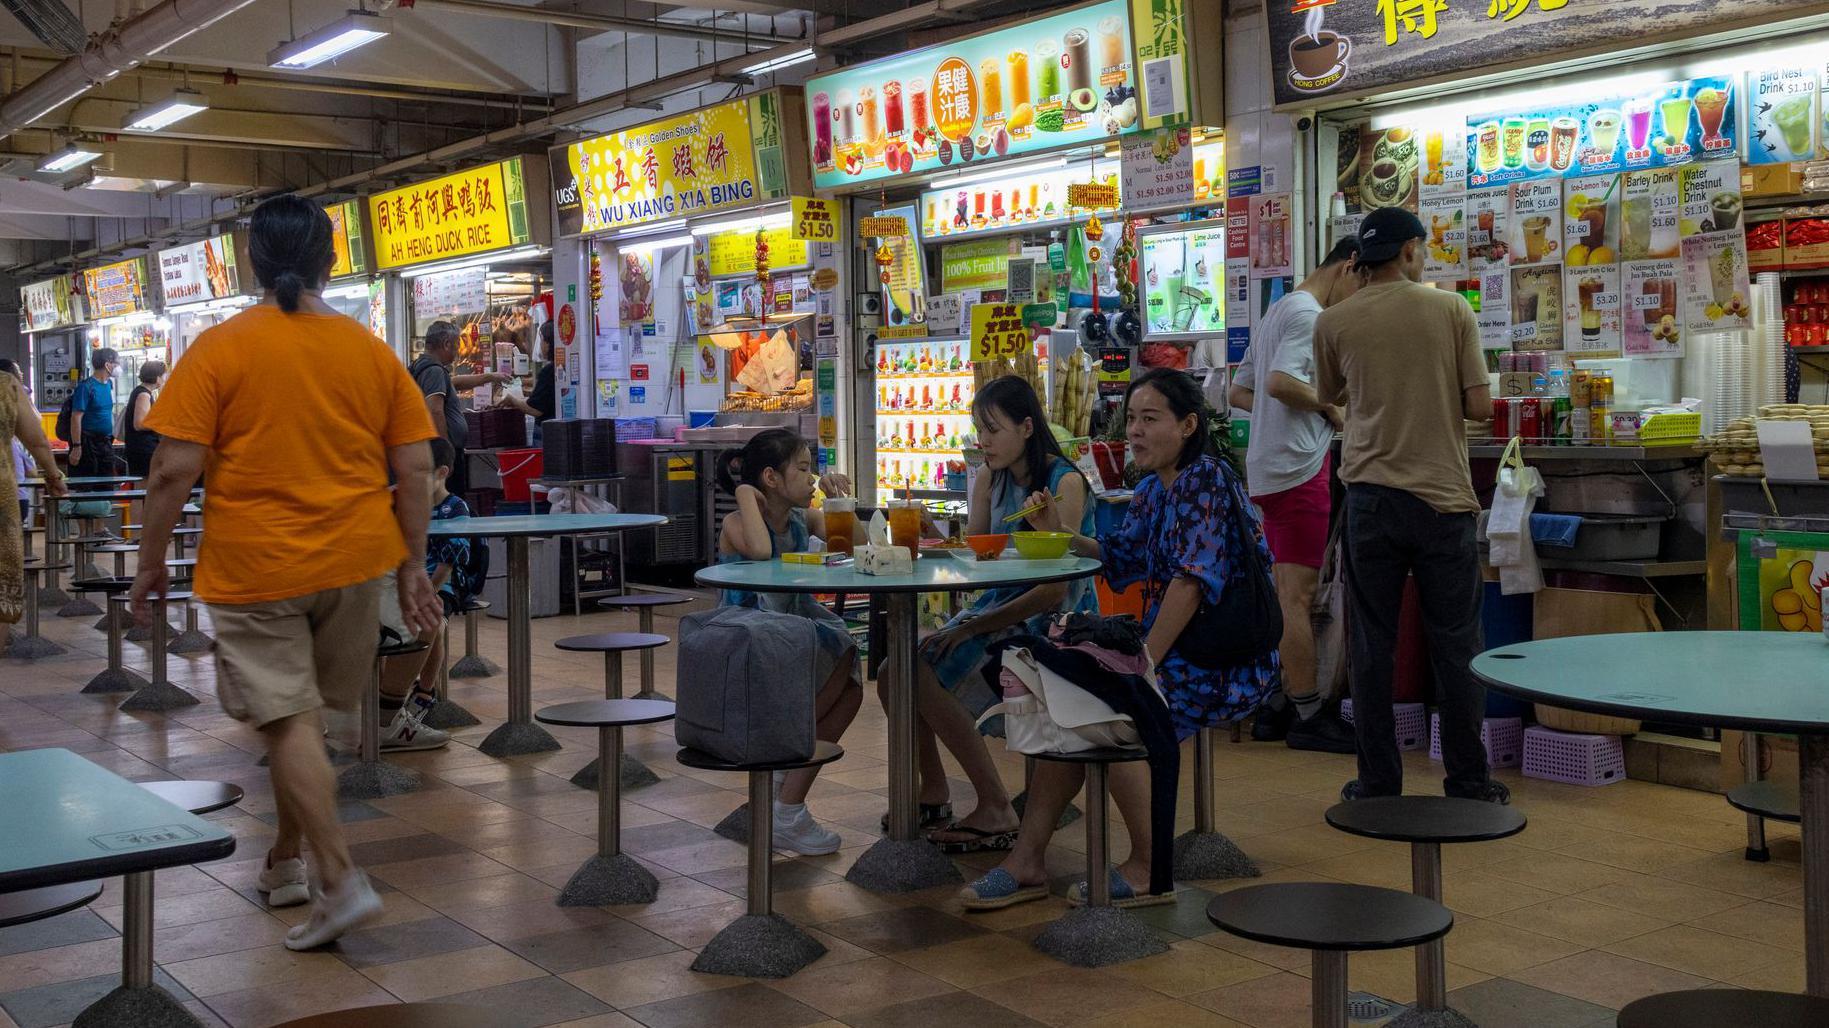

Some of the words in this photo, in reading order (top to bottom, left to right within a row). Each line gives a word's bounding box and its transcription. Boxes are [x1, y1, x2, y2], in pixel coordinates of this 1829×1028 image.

[1314, 72, 1341, 87] COFFEE
[1760, 68, 1779, 82] Bird
[1782, 67, 1802, 79] Nest
[1760, 81, 1784, 94] Drink
[1788, 81, 1814, 93] $1.10
[649, 131, 673, 143] Golden
[1155, 173, 1174, 183] $1.50
[1175, 169, 1193, 179] $2.00
[1445, 169, 1464, 179] $1.60
[1626, 176, 1650, 188] Barley
[1653, 172, 1674, 184] Drink
[1683, 169, 1707, 181] Water
[1571, 182, 1600, 191] Ice-Lemon
[1601, 180, 1610, 188] Tea
[1683, 177, 1722, 192] Chestnut
[1136, 188, 1154, 199] $1.50
[1156, 186, 1174, 196] $2.00
[1515, 188, 1531, 198] Sour
[1533, 185, 1551, 196] Plum
[1684, 190, 1707, 203] Drink
[600, 205, 624, 223] WU
[628, 195, 675, 220] XIANG
[679, 189, 706, 210] XIA
[710, 179, 753, 204] BING
[1421, 200, 1442, 208] Honey
[1442, 198, 1463, 206] Lemon
[1515, 198, 1534, 209] Drink
[1537, 198, 1559, 208] $1.60
[1654, 196, 1677, 207] $1.10
[1684, 204, 1709, 216] $1.10
[1229, 218, 1246, 226] NETS
[1652, 217, 1676, 228] $1.60
[799, 220, 834, 238] $1.50
[1566, 225, 1587, 235] $1.60
[391, 243, 404, 261] AH
[406, 236, 433, 259] HENG
[435, 230, 463, 253] DUCK
[467, 224, 492, 247] RICE
[1445, 232, 1465, 241] $2.20
[1469, 234, 1488, 243] $1.60
[1701, 234, 1726, 244] Nutmeg
[1727, 231, 1743, 240] Juice
[1713, 241, 1735, 249] Lemon
[946, 261, 971, 277] 100%
[973, 257, 995, 274] Fruit
[1573, 268, 1589, 276] Layer
[1630, 263, 1655, 272] Nutmeg
[1656, 261, 1674, 269] drink
[1596, 294, 1618, 305] $3.20
[1635, 296, 1659, 306] $1.10
[1513, 326, 1535, 338] $2.20
[980, 332, 1026, 357] $1.50
